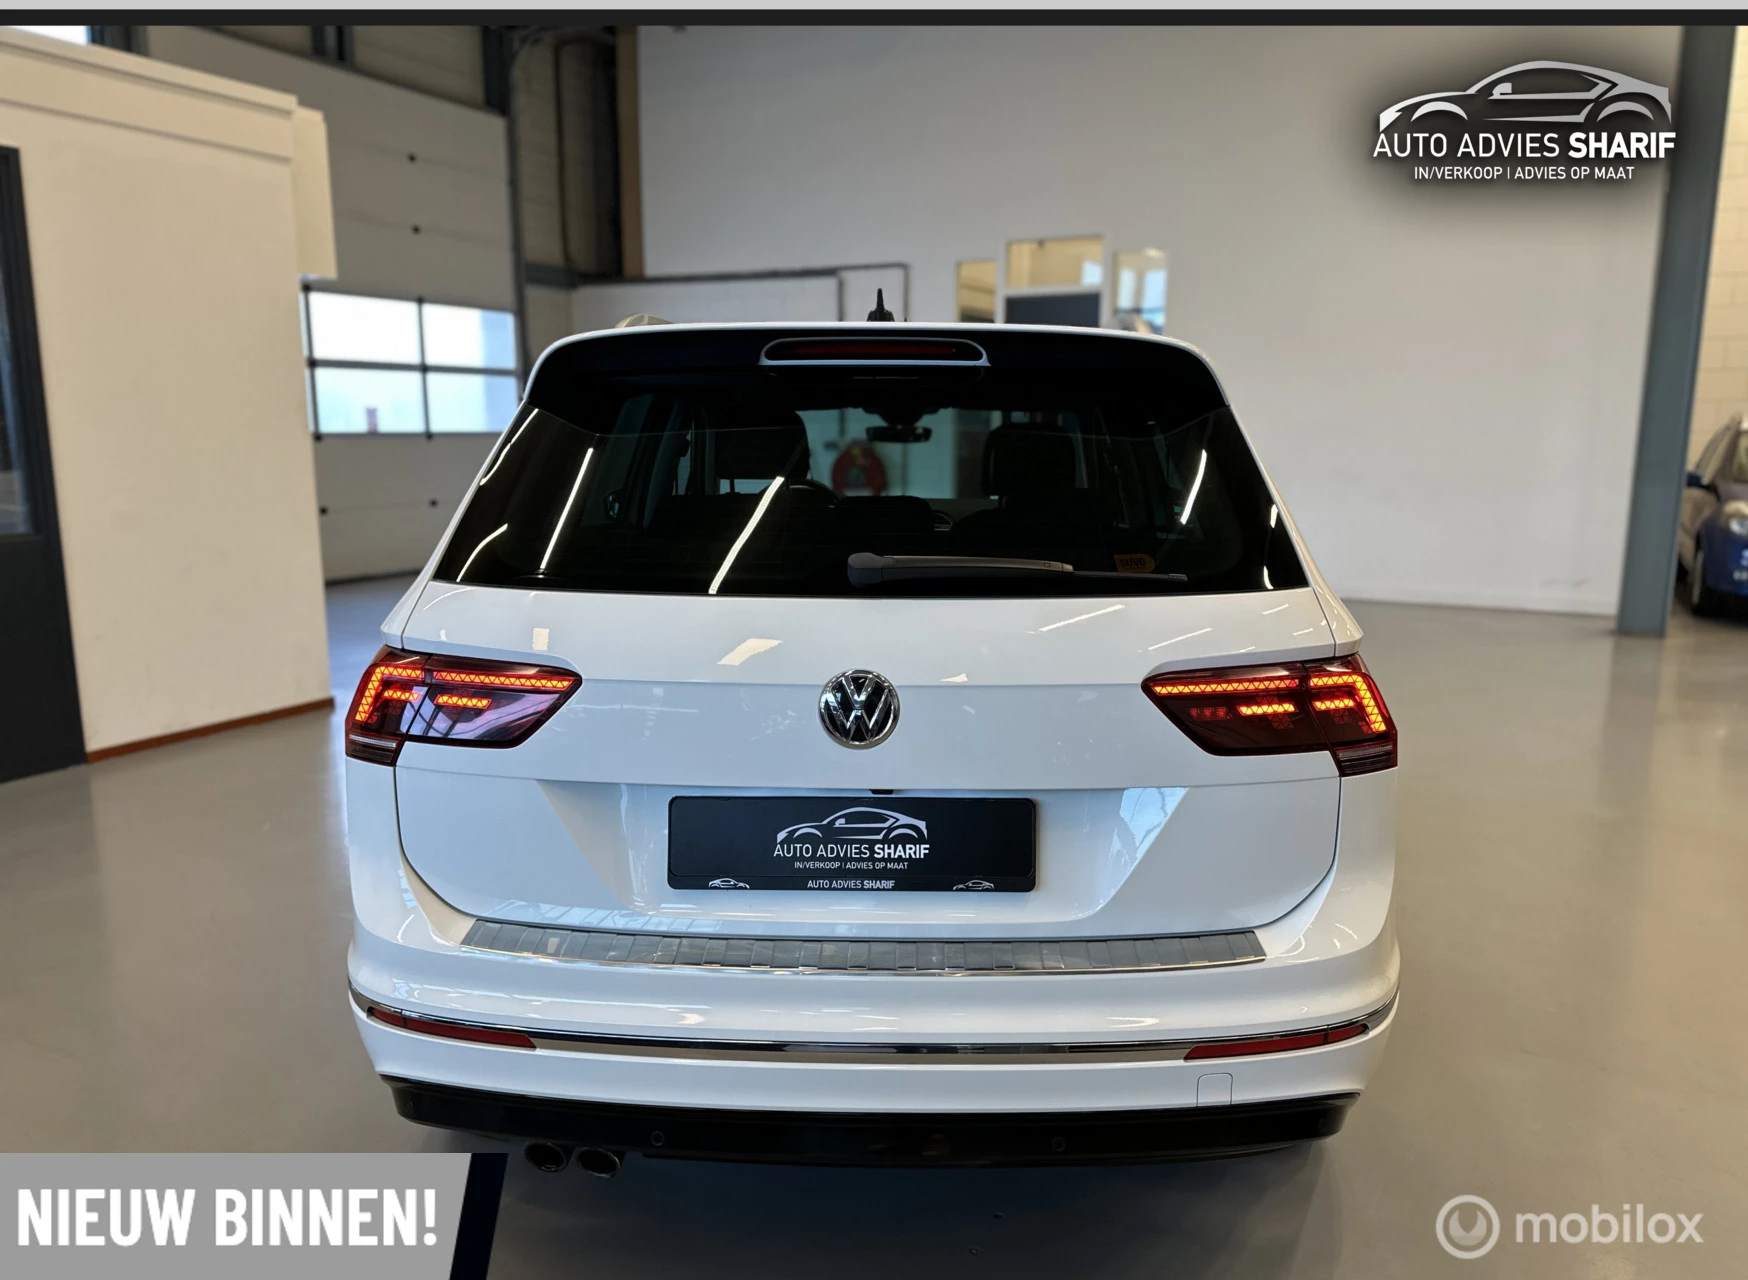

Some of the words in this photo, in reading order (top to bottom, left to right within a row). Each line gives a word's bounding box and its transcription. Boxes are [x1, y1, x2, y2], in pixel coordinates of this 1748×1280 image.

[773, 843, 812, 858] AUTO
[816, 843, 870, 858] ADVIES
[873, 843, 930, 859] SHARIF
[794, 861, 841, 869] IN/VERKOOP
[846, 861, 874, 869] ADVIES
[875, 861, 886, 870] OP
[887, 861, 909, 870] MAAT
[807, 879, 830, 889] AUTO
[831, 879, 862, 889] ADVIES
[863, 879, 896, 889] SHARIF
